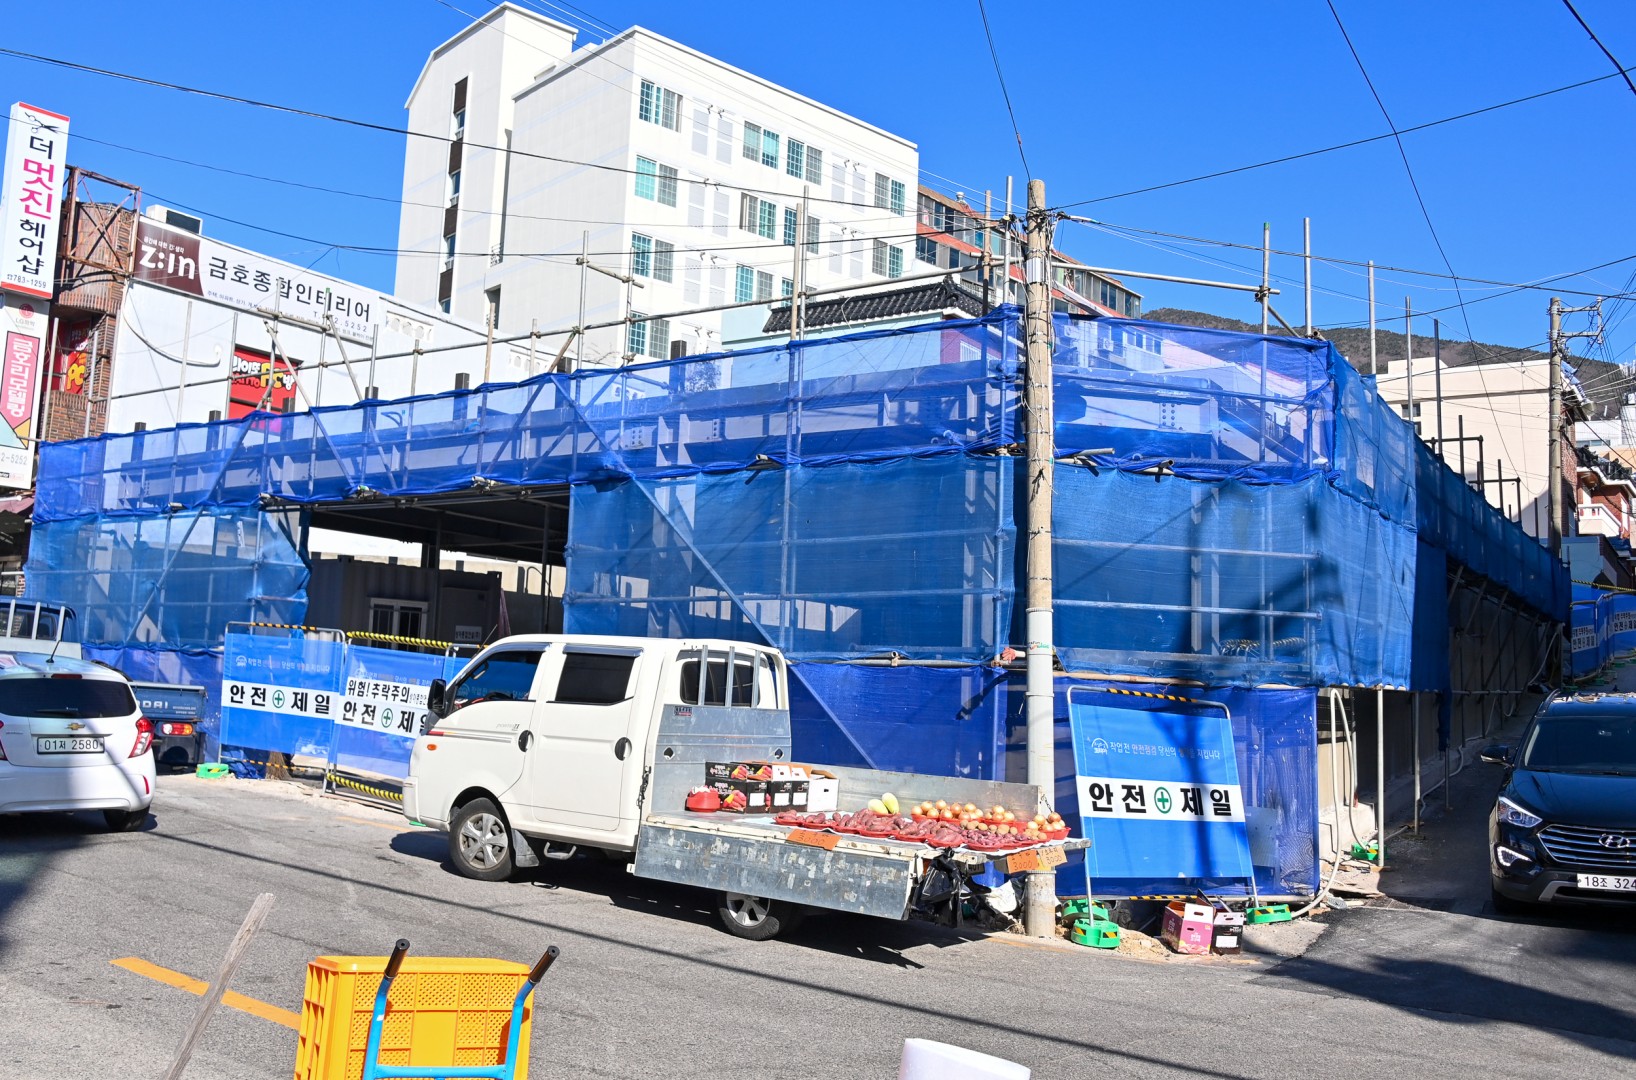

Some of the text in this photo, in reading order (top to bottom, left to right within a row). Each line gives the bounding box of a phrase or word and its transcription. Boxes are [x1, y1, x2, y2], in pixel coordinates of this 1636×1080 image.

[29, 135, 54, 160] 더
[19, 158, 54, 220] 멋진
[16, 218, 46, 276] 헤어샵
[13, 273, 47, 289] 783-1259
[6, 337, 34, 418] 금호리모델링
[66, 363, 86, 391] PC
[230, 684, 331, 715] 안전 제일
[348, 679, 371, 698] 위험!
[371, 682, 411, 704] 추락주의
[342, 700, 377, 726] 안전
[44, 739, 99, 751] 01저 2580
[1088, 782, 1233, 817] 안전 제일
[1013, 860, 1034, 872] 3000
[1584, 875, 1608, 888] 18조
